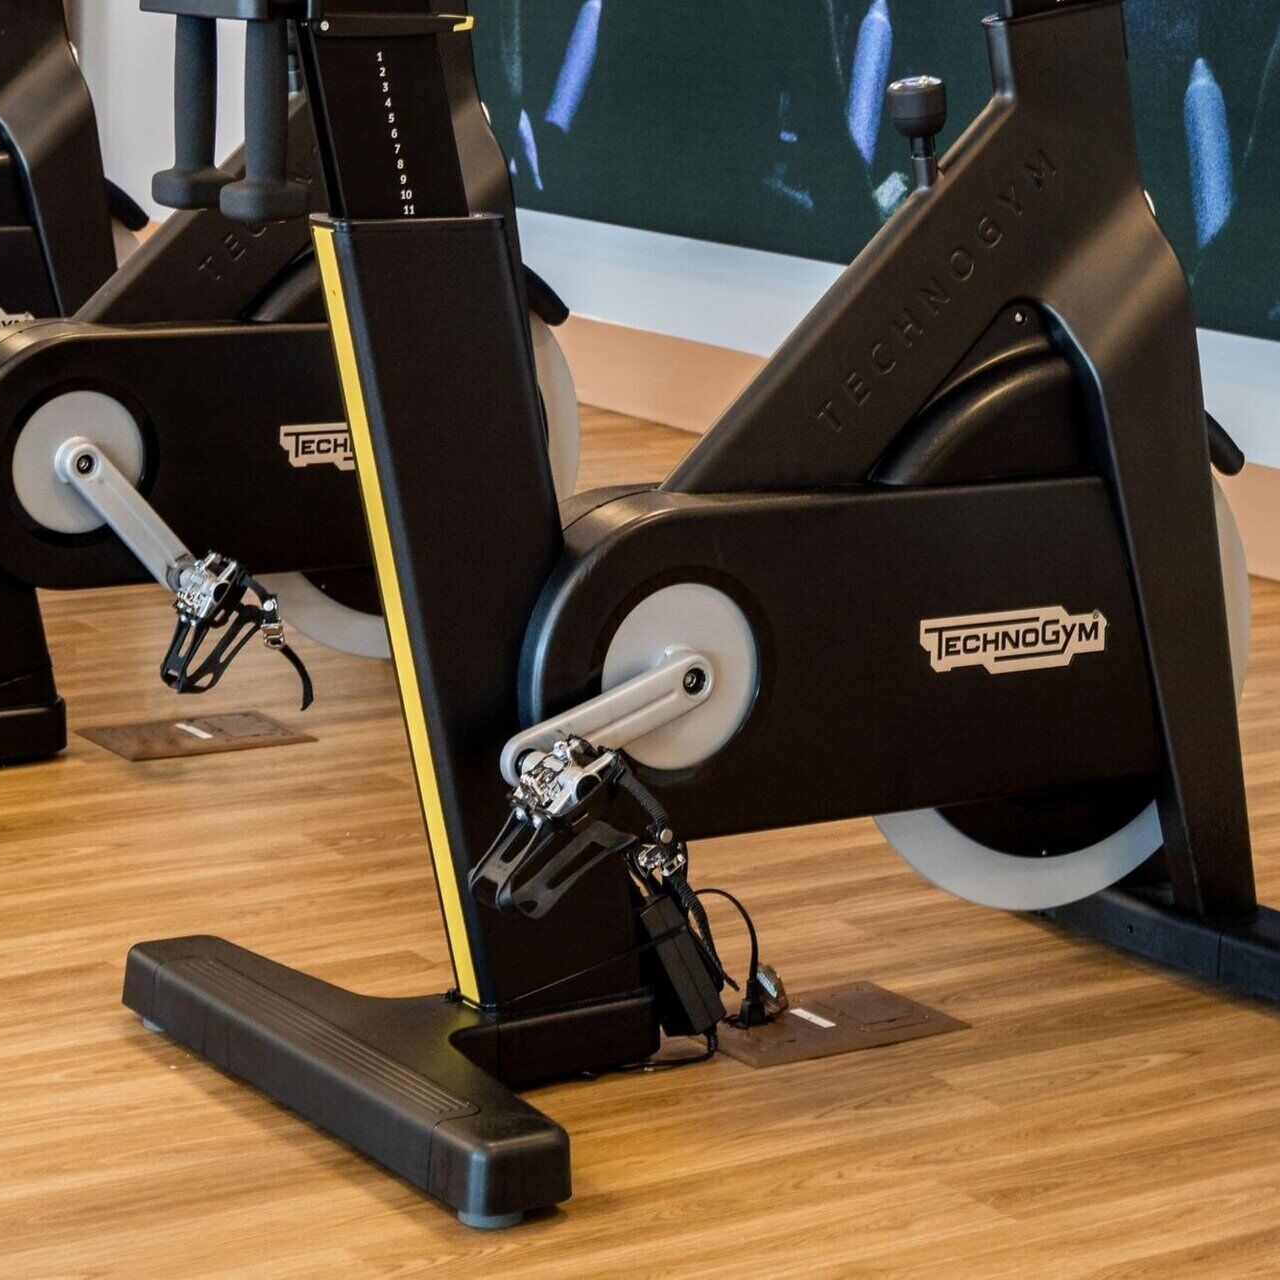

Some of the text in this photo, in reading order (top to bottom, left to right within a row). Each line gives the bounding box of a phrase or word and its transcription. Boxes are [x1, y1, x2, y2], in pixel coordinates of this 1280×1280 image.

[377, 52, 382, 61] 1
[380, 67, 385, 77] 2
[383, 82, 388, 92] 3
[385, 98, 391, 107] 4
[388, 113, 394, 123] 5
[391, 128, 398, 138] 6
[395, 144, 400, 154] 7
[397, 159, 404, 169] 8
[400, 174, 407, 184] 9
[401, 190, 412, 199] 10
[404, 205, 414, 214] 11
[817, 148, 1057, 432] TECHNOGYM
[283, 429, 353, 458] TECH
[924, 616, 1099, 661] TECHNOGYM
